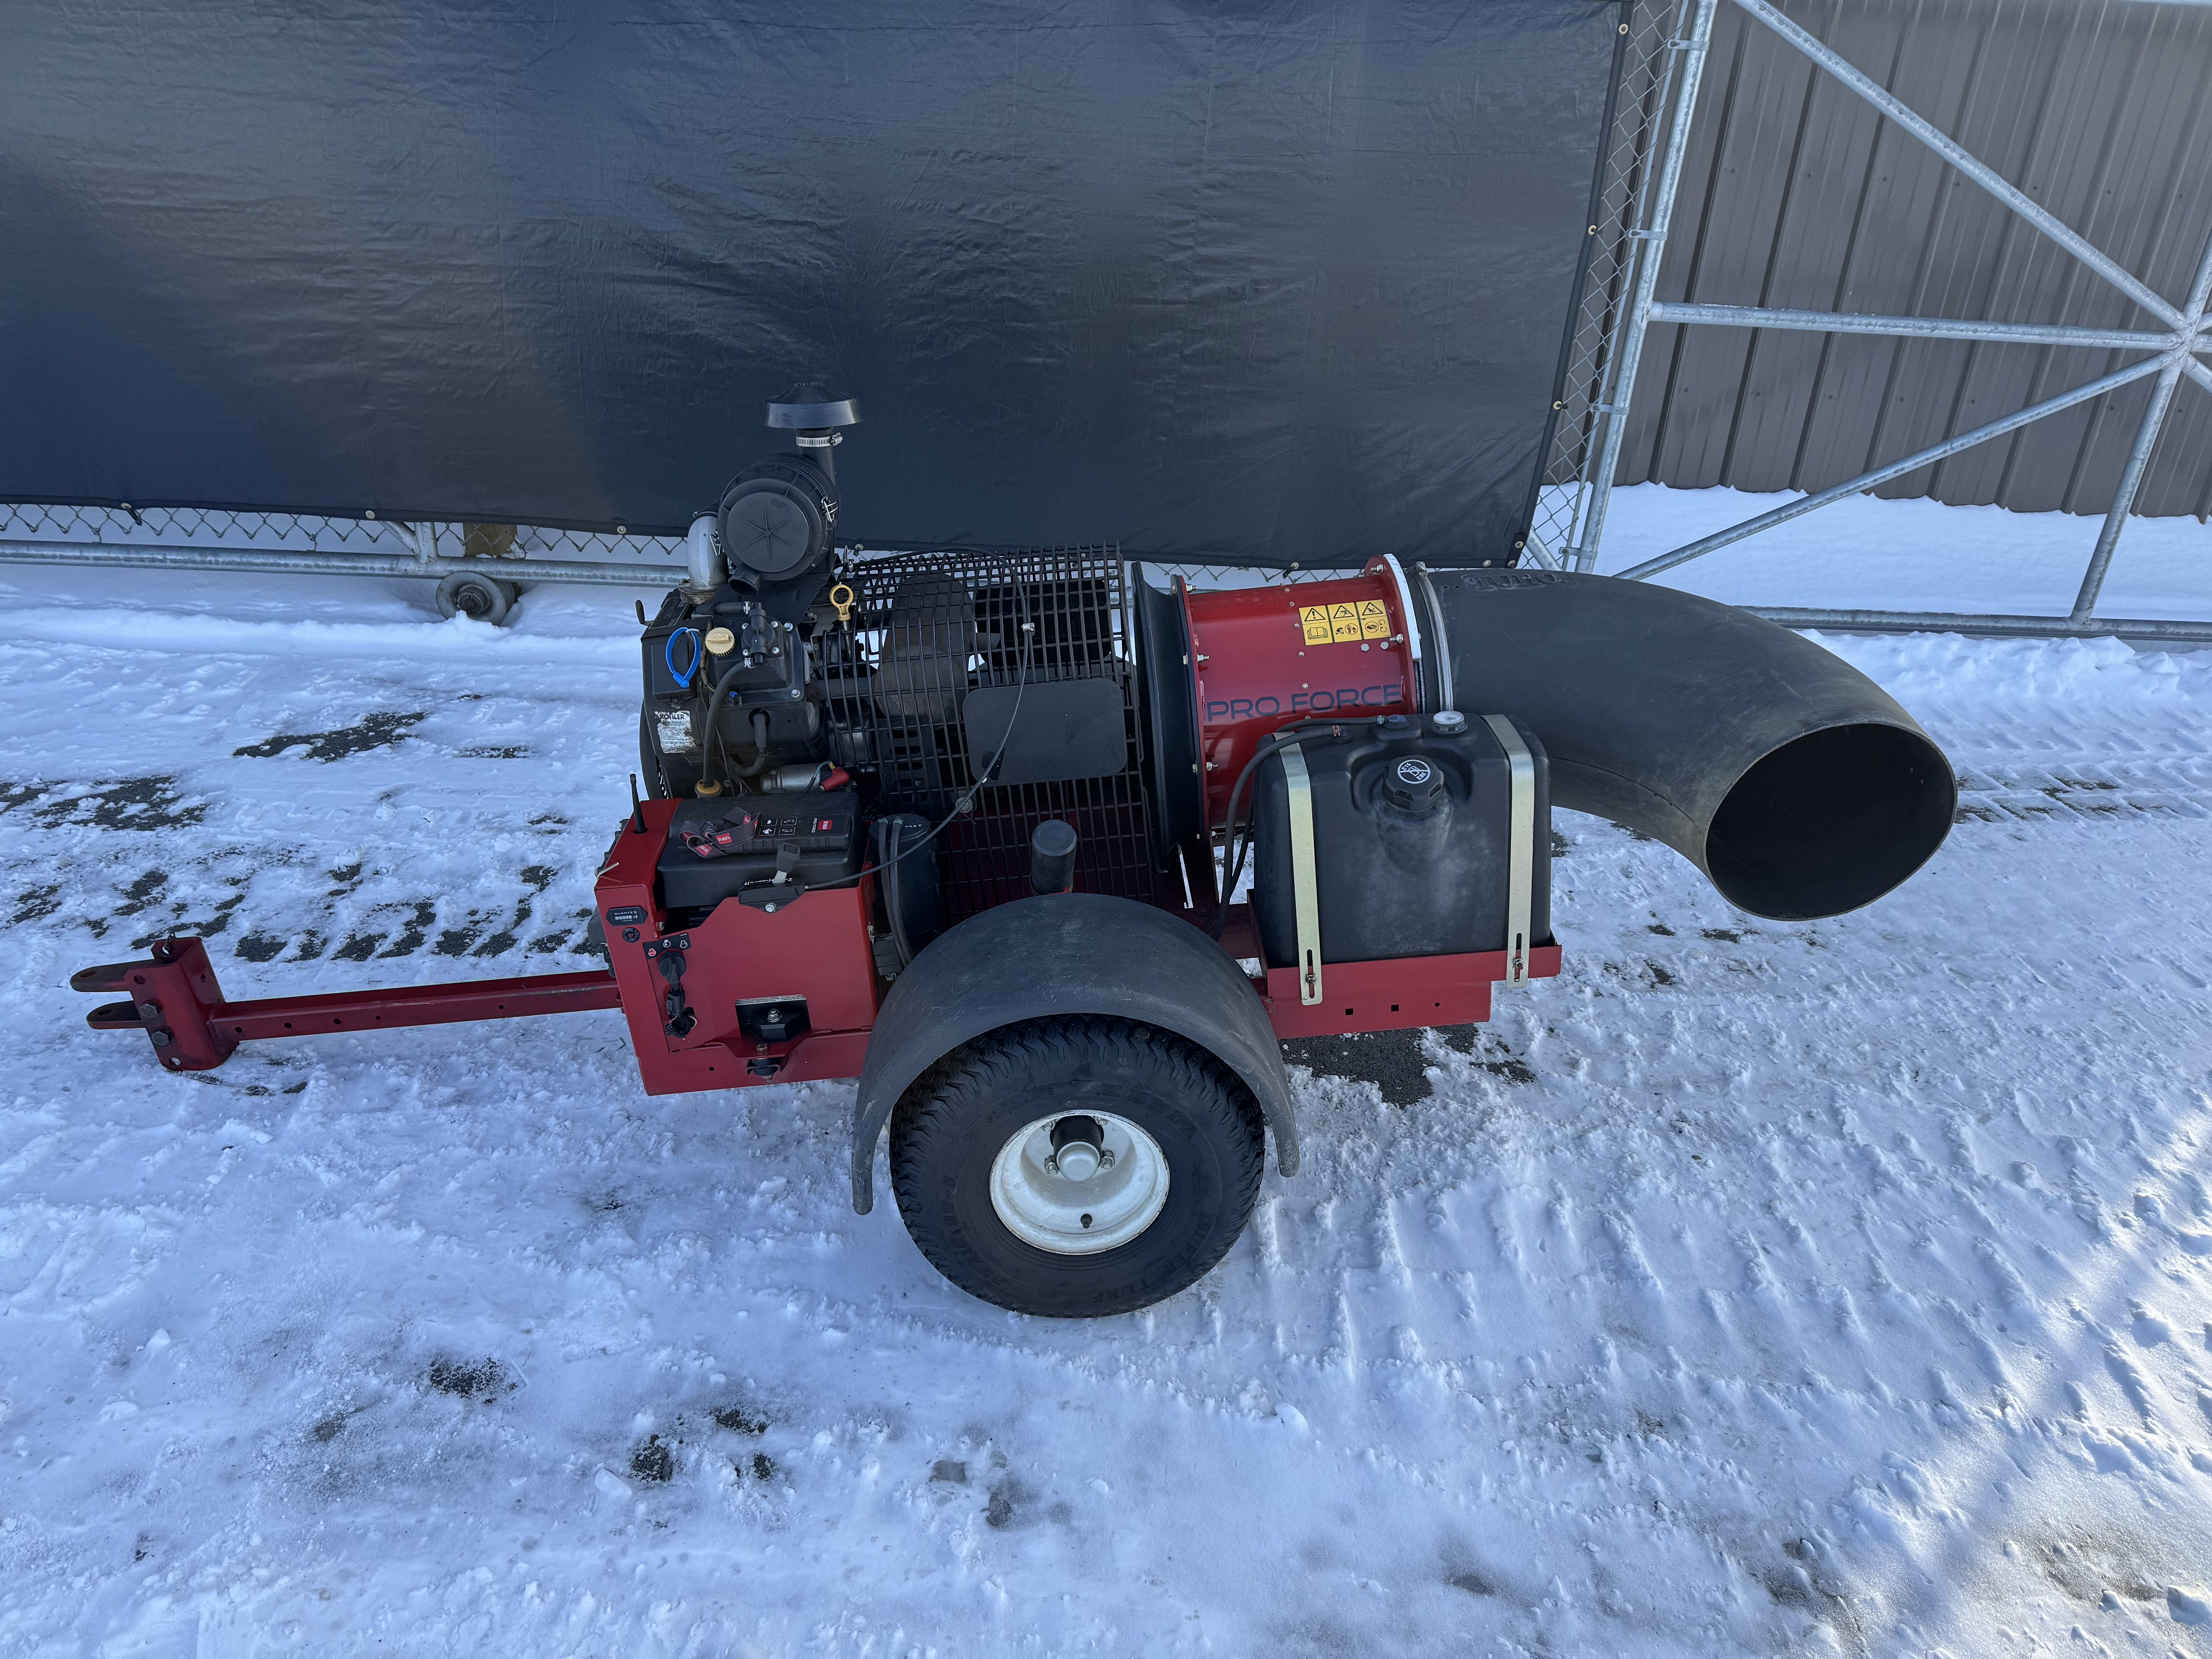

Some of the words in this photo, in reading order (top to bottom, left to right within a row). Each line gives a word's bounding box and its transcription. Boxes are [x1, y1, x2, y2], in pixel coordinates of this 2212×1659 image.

[1207, 696, 1280, 722] PRO
[1291, 684, 1402, 714] FORCE
[1401, 763, 1412, 771] E15
[1416, 772, 1427, 781] E85
[1100, 1082, 1197, 1139] KENDA
[1161, 1219, 1213, 1274] SUPER
